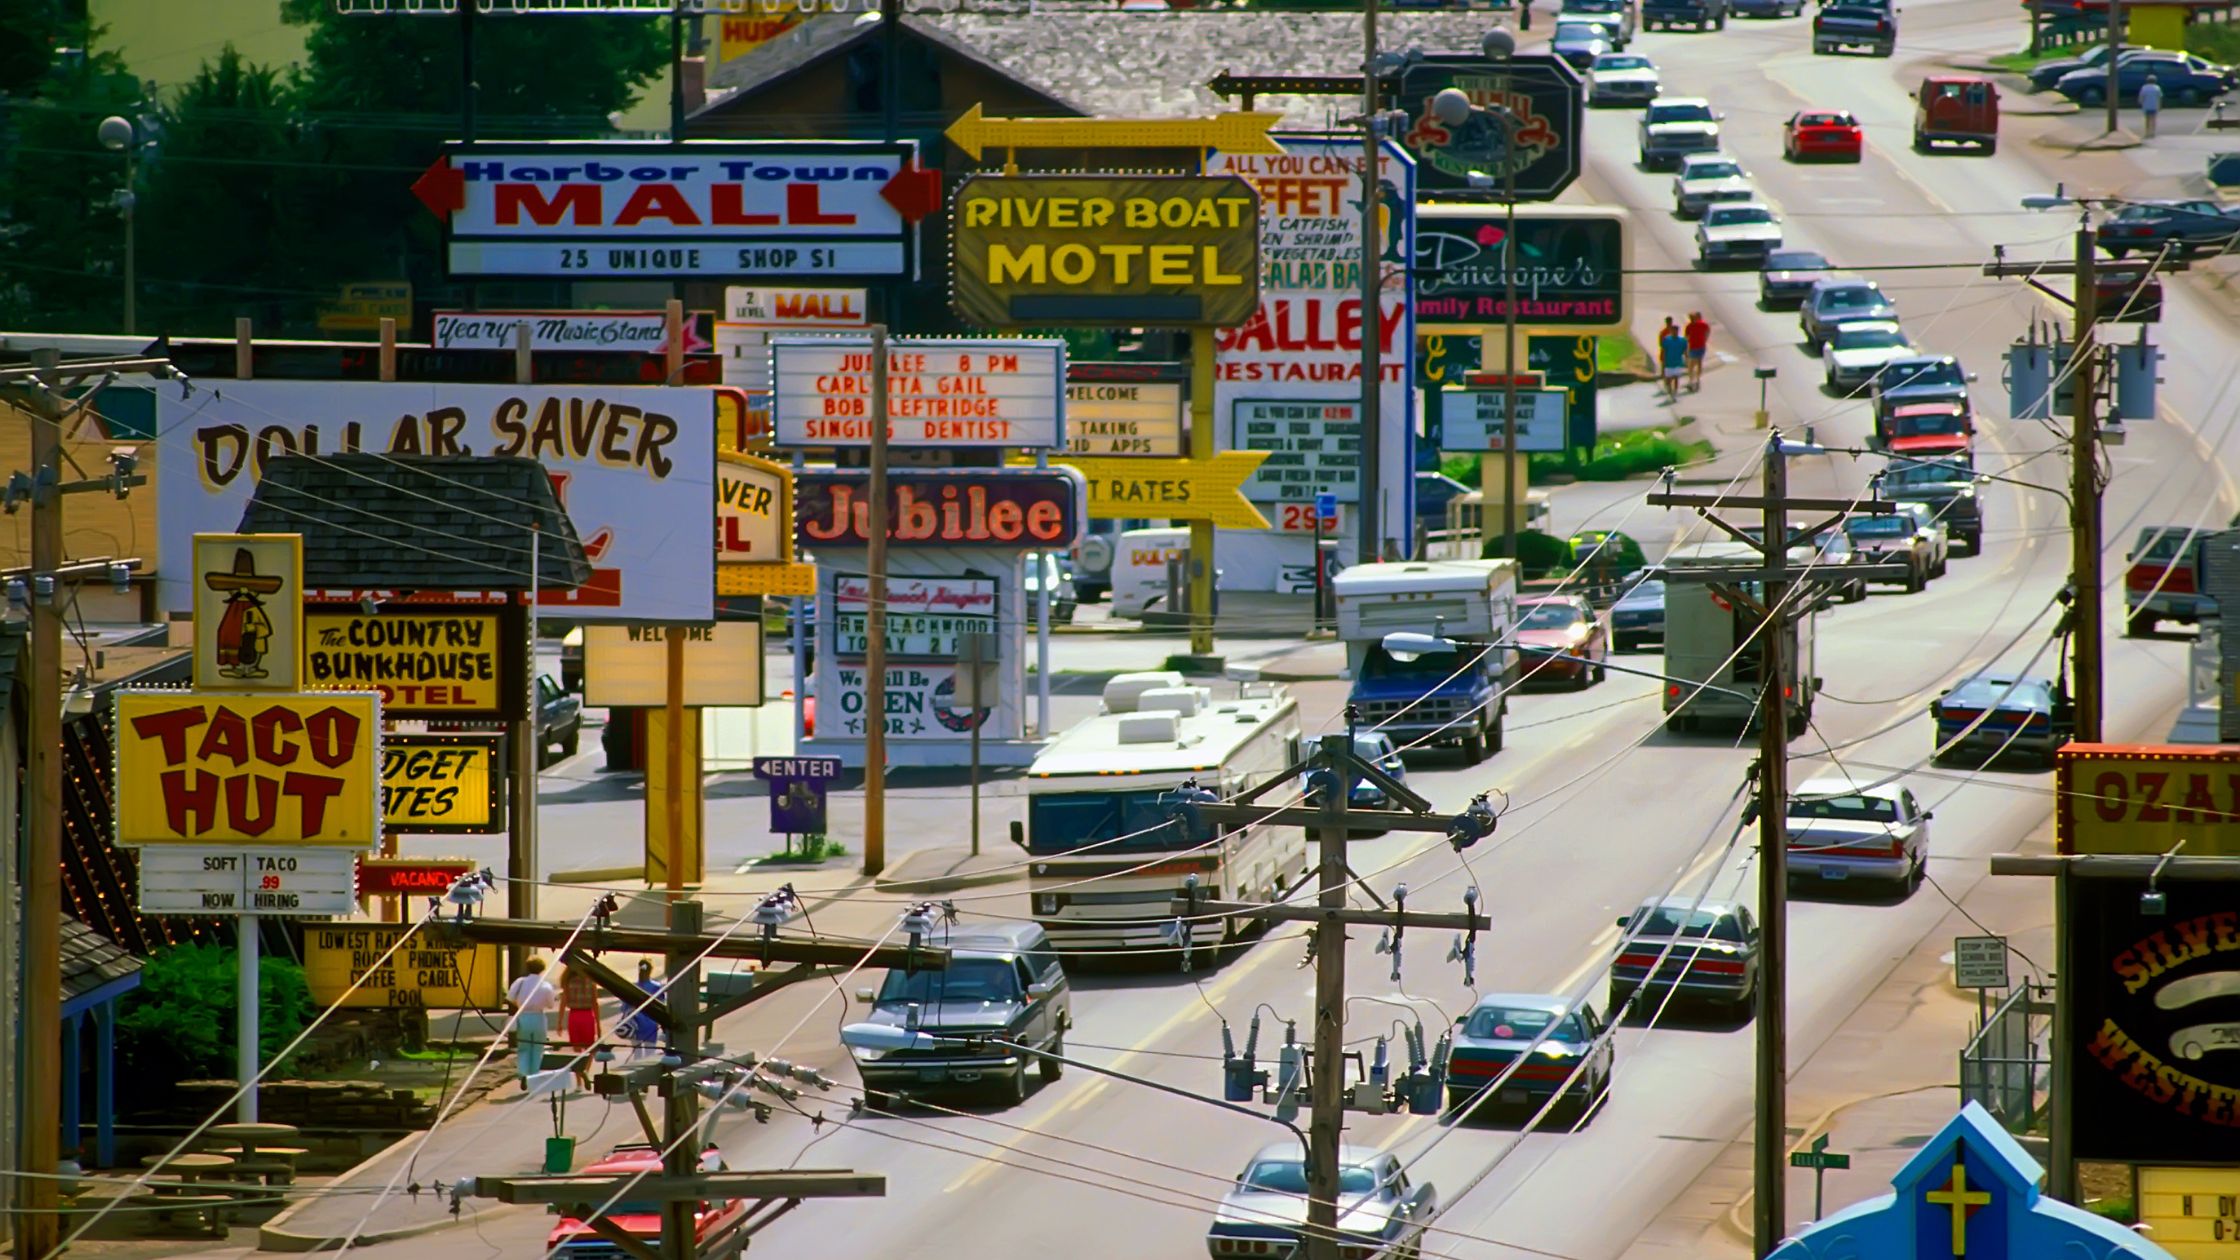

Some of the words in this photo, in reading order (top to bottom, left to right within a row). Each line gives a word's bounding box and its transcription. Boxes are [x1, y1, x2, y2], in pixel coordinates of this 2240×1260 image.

[463, 162, 699, 181] Harbor
[719, 161, 890, 181] Town
[1225, 157, 1259, 173] ALL
[1264, 157, 1303, 173] YOU
[1310, 156, 1349, 174] CAN
[1357, 157, 1390, 175] ET
[495, 184, 857, 226] MALL
[1258, 179, 1347, 215] FFET
[966, 198, 1115, 228] RIVER
[1125, 198, 1250, 228] BOAT
[1280, 219, 1350, 231] CATFISH
[560, 249, 589, 268] 25
[608, 249, 700, 268] UNIQUE
[988, 245, 1243, 285] MOTEL
[1416, 232, 1602, 300] Penelope's
[1332, 263, 1362, 288] BA
[736, 306, 765, 318] LEVEL
[775, 294, 861, 319] MALL
[537, 319, 598, 343] Music
[838, 354, 926, 372] JULEE
[959, 354, 970, 372] 8
[989, 355, 1018, 372] PM
[1216, 363, 1404, 381] ESTAURAT
[816, 375, 923, 394] CARLTTA
[937, 375, 986, 394] GAIL
[824, 399, 864, 415] BOB
[806, 420, 893, 438] SINGIG
[925, 421, 1011, 438] DENTIST
[1080, 421, 1138, 434] TAKING
[494, 397, 679, 479] SAVER
[1110, 439, 1152, 452] APPS
[1111, 480, 1190, 501] RATES
[806, 485, 1063, 540] Jubilee
[318, 628, 347, 646] The
[348, 619, 484, 648] COUNTRY
[628, 625, 712, 641] WELME
[848, 636, 906, 651] TOAY
[310, 651, 494, 682] BUNKHOUSE
[839, 671, 862, 687] We
[909, 671, 930, 687] Be
[350, 685, 477, 705] OTEL
[841, 691, 924, 714] OEN
[130, 705, 361, 769] TACO
[382, 750, 478, 780] DGET
[771, 760, 834, 777] ENTER
[160, 768, 346, 839] HUT
[383, 785, 459, 816] ATES
[2095, 767, 2240, 823] OZA
[203, 857, 238, 871] SOFT
[257, 857, 298, 871] TACO
[202, 892, 235, 907] NOW
[254, 892, 300, 908] HIRING
[319, 931, 370, 949] LOWEST
[409, 951, 458, 968] PHONES
[2112, 911, 2240, 995] SILVE
[417, 970, 459, 987] CABLE
[2087, 1018, 2240, 1128] WESTE
